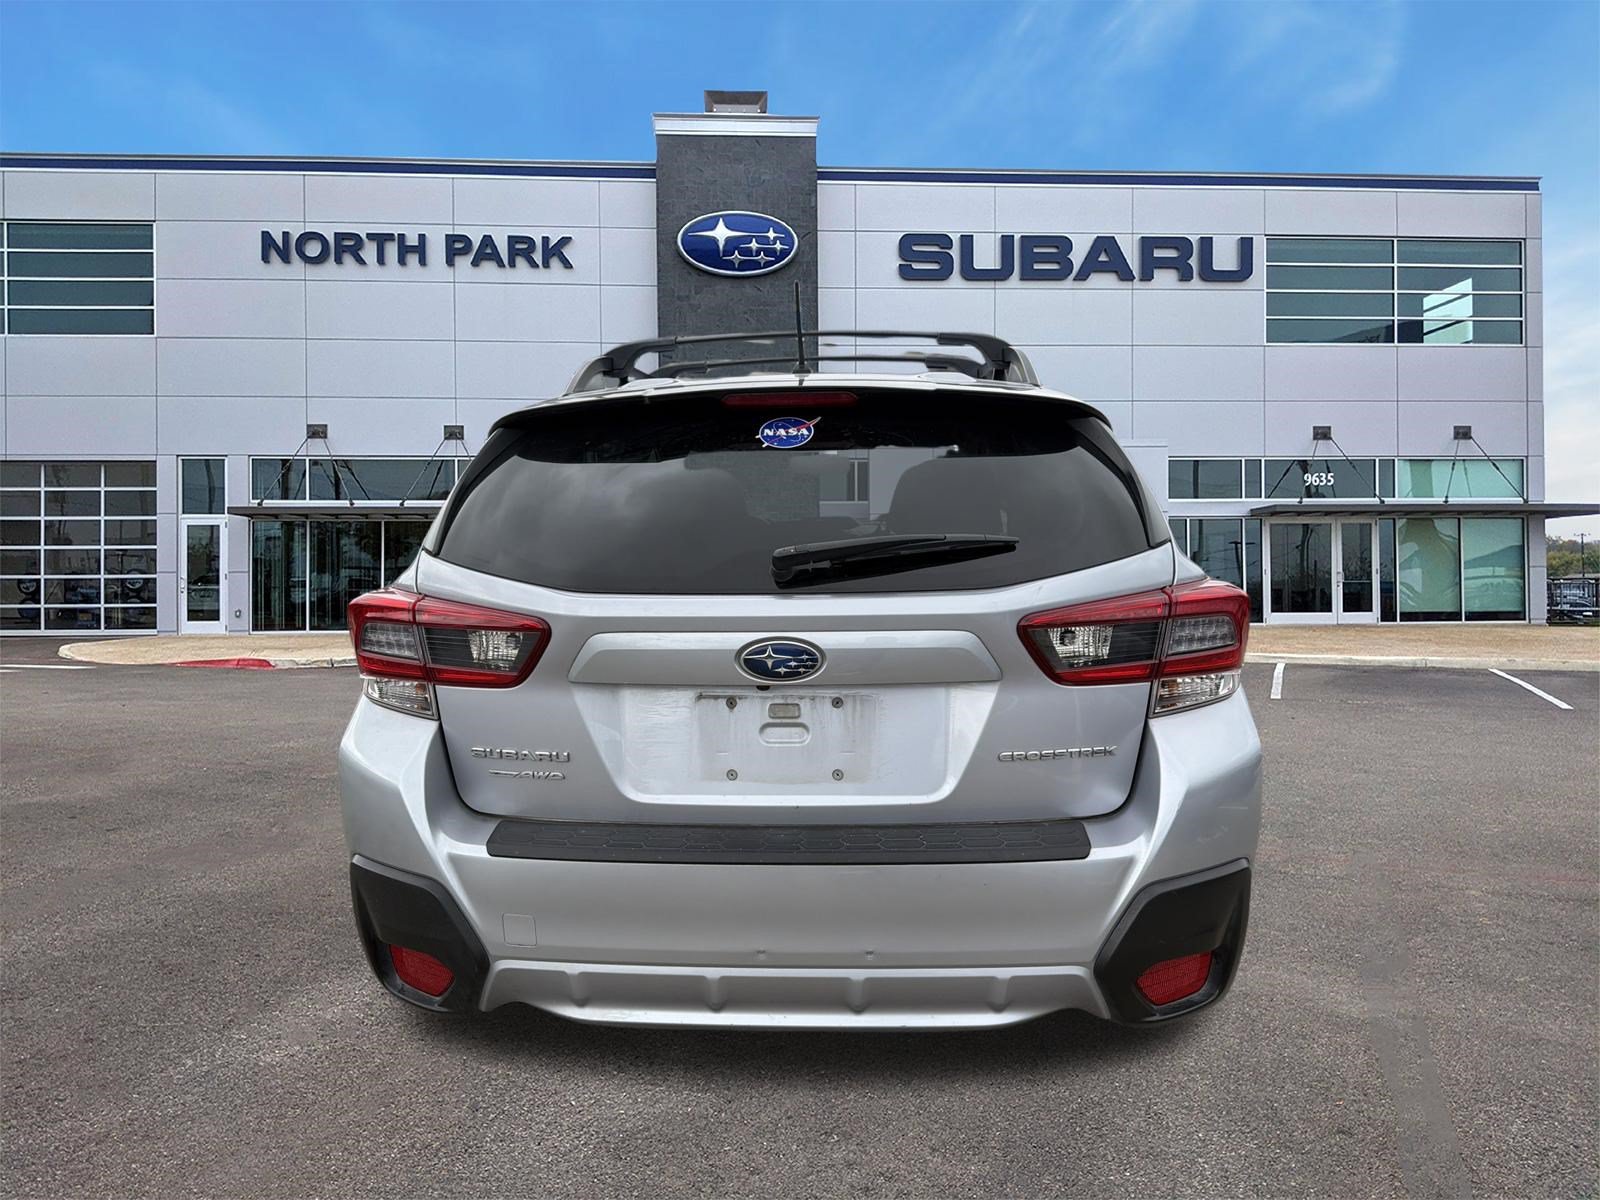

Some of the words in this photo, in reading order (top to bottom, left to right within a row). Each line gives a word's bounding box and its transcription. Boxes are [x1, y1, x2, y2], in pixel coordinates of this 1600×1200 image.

[260, 231, 427, 266] NORTH
[445, 233, 574, 269] PARK
[898, 233, 1254, 282] SUBARU
[763, 427, 810, 436] NASA
[1303, 472, 1335, 486] 9635
[470, 746, 571, 763] SUBARU
[998, 744, 1118, 761] CROSSTREK
[513, 769, 566, 780] AWD
